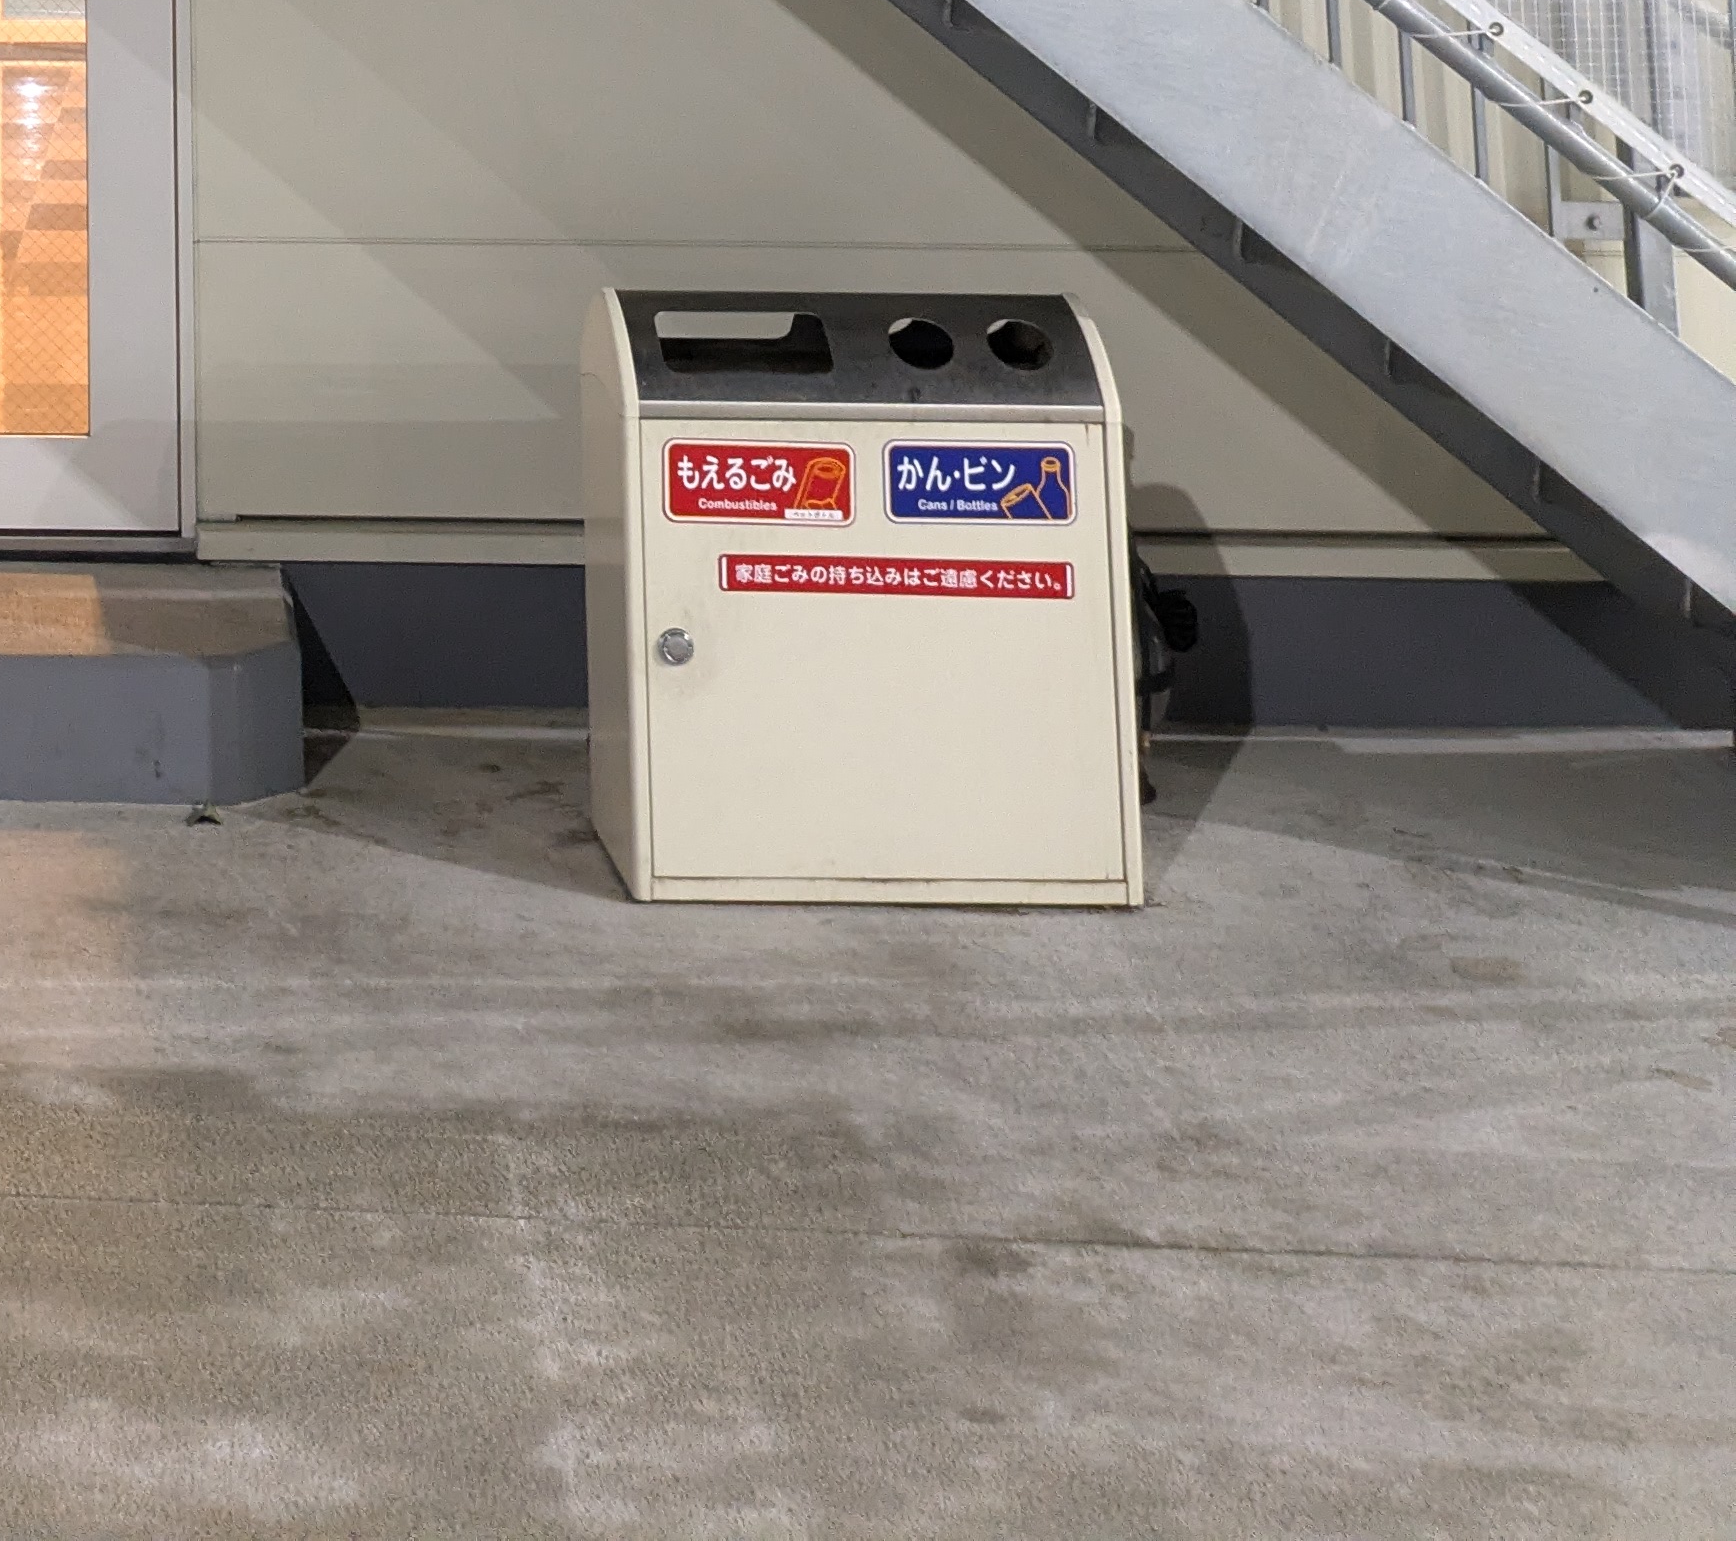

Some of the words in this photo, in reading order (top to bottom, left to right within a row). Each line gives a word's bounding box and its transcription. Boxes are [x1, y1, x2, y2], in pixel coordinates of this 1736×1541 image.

[677, 455, 797, 492] もえるごみ
[698, 497, 778, 512] Combustibles
[917, 499, 948, 511] Cans
[956, 499, 998, 512] Bottles
[735, 563, 1063, 592] 家庭ごみの持ち込みはご遠慮ください。
